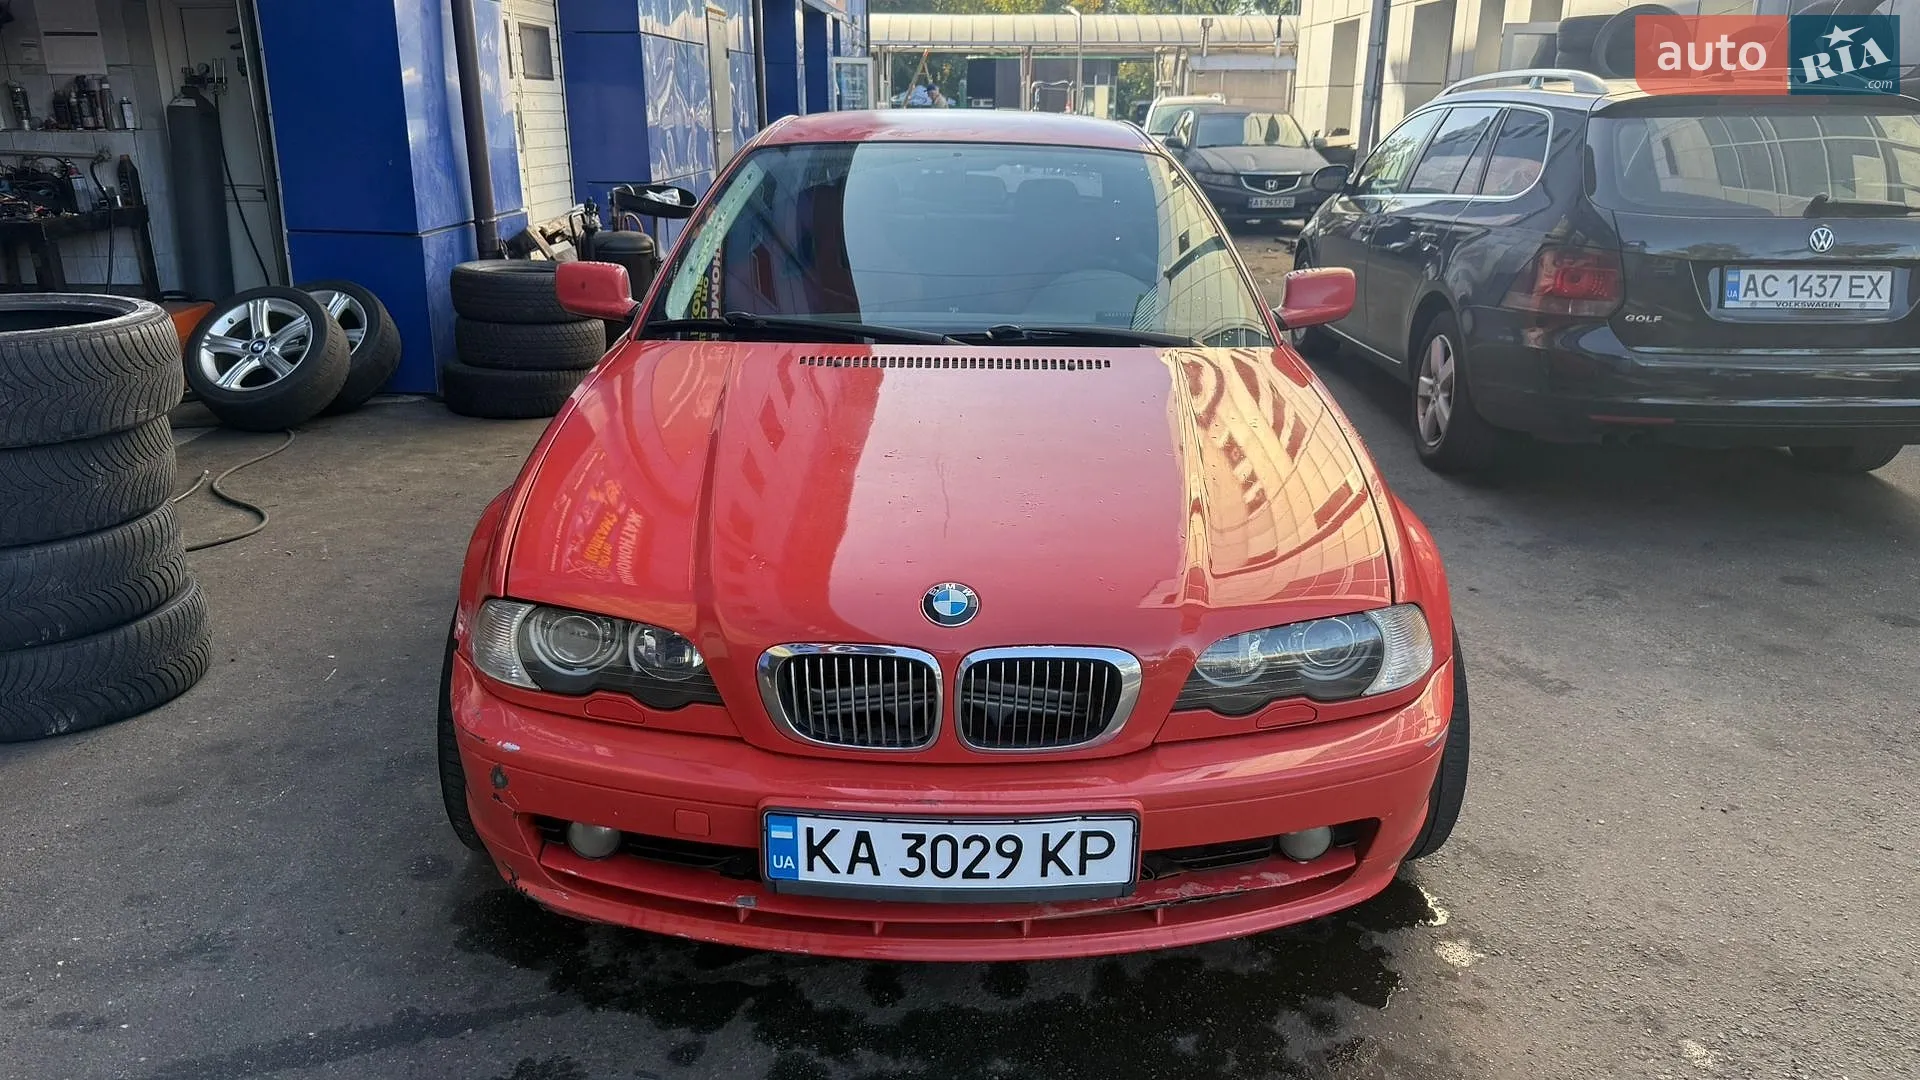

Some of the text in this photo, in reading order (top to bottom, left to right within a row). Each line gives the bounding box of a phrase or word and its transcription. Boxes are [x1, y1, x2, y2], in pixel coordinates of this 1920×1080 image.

[1743, 274, 1884, 300] AC 1437 EX
[1624, 315, 1663, 323] GOLF
[928, 583, 975, 597] BMW
[805, 827, 1116, 880] KA 3029 KP
[773, 855, 795, 870] UA
